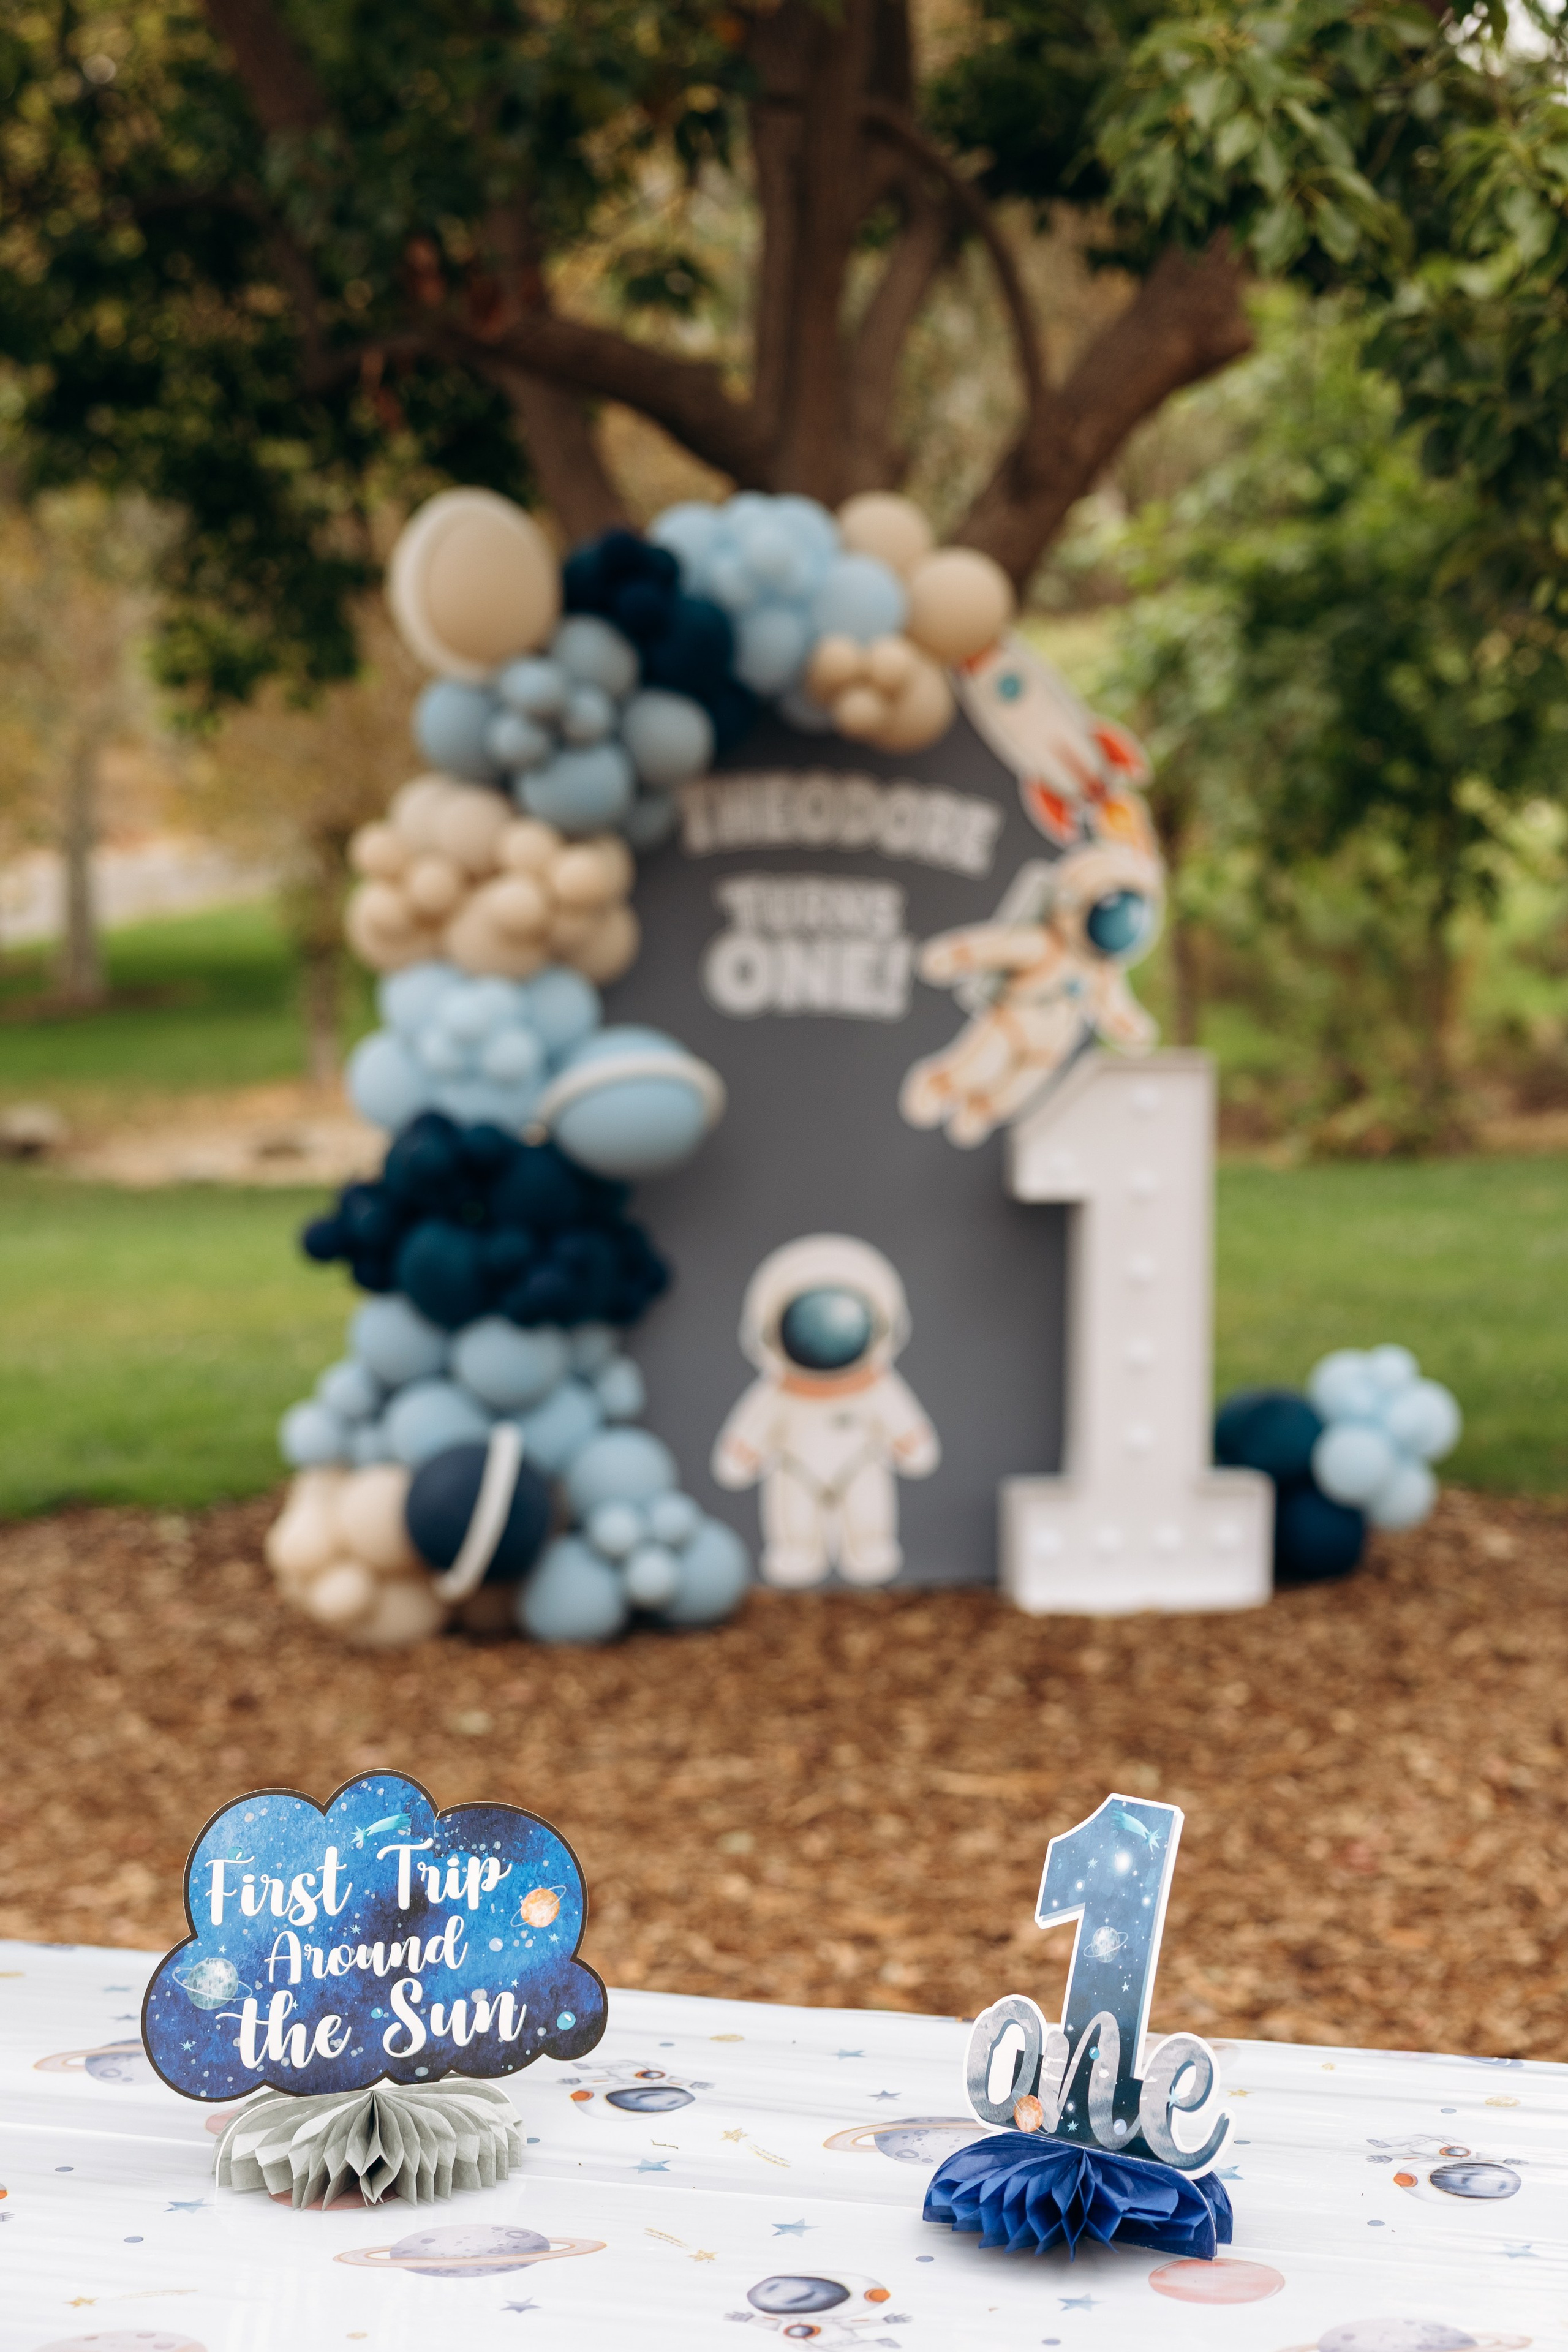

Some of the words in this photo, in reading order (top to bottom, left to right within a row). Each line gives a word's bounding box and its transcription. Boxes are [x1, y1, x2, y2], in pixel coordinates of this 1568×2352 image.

[681, 772, 1001, 876] THEODORE
[717, 876, 904, 936] TURNS
[704, 932, 914, 1017] ONE!
[1002, 1050, 1274, 1612] 1
[206, 1846, 353, 1926] First
[377, 1838, 512, 1910] Trip
[264, 1915, 468, 1984] Around
[1017, 1795, 1183, 2153] 1
[215, 1990, 352, 2069] the
[383, 1978, 527, 2058] Sun
[966, 1998, 1231, 2172] one
